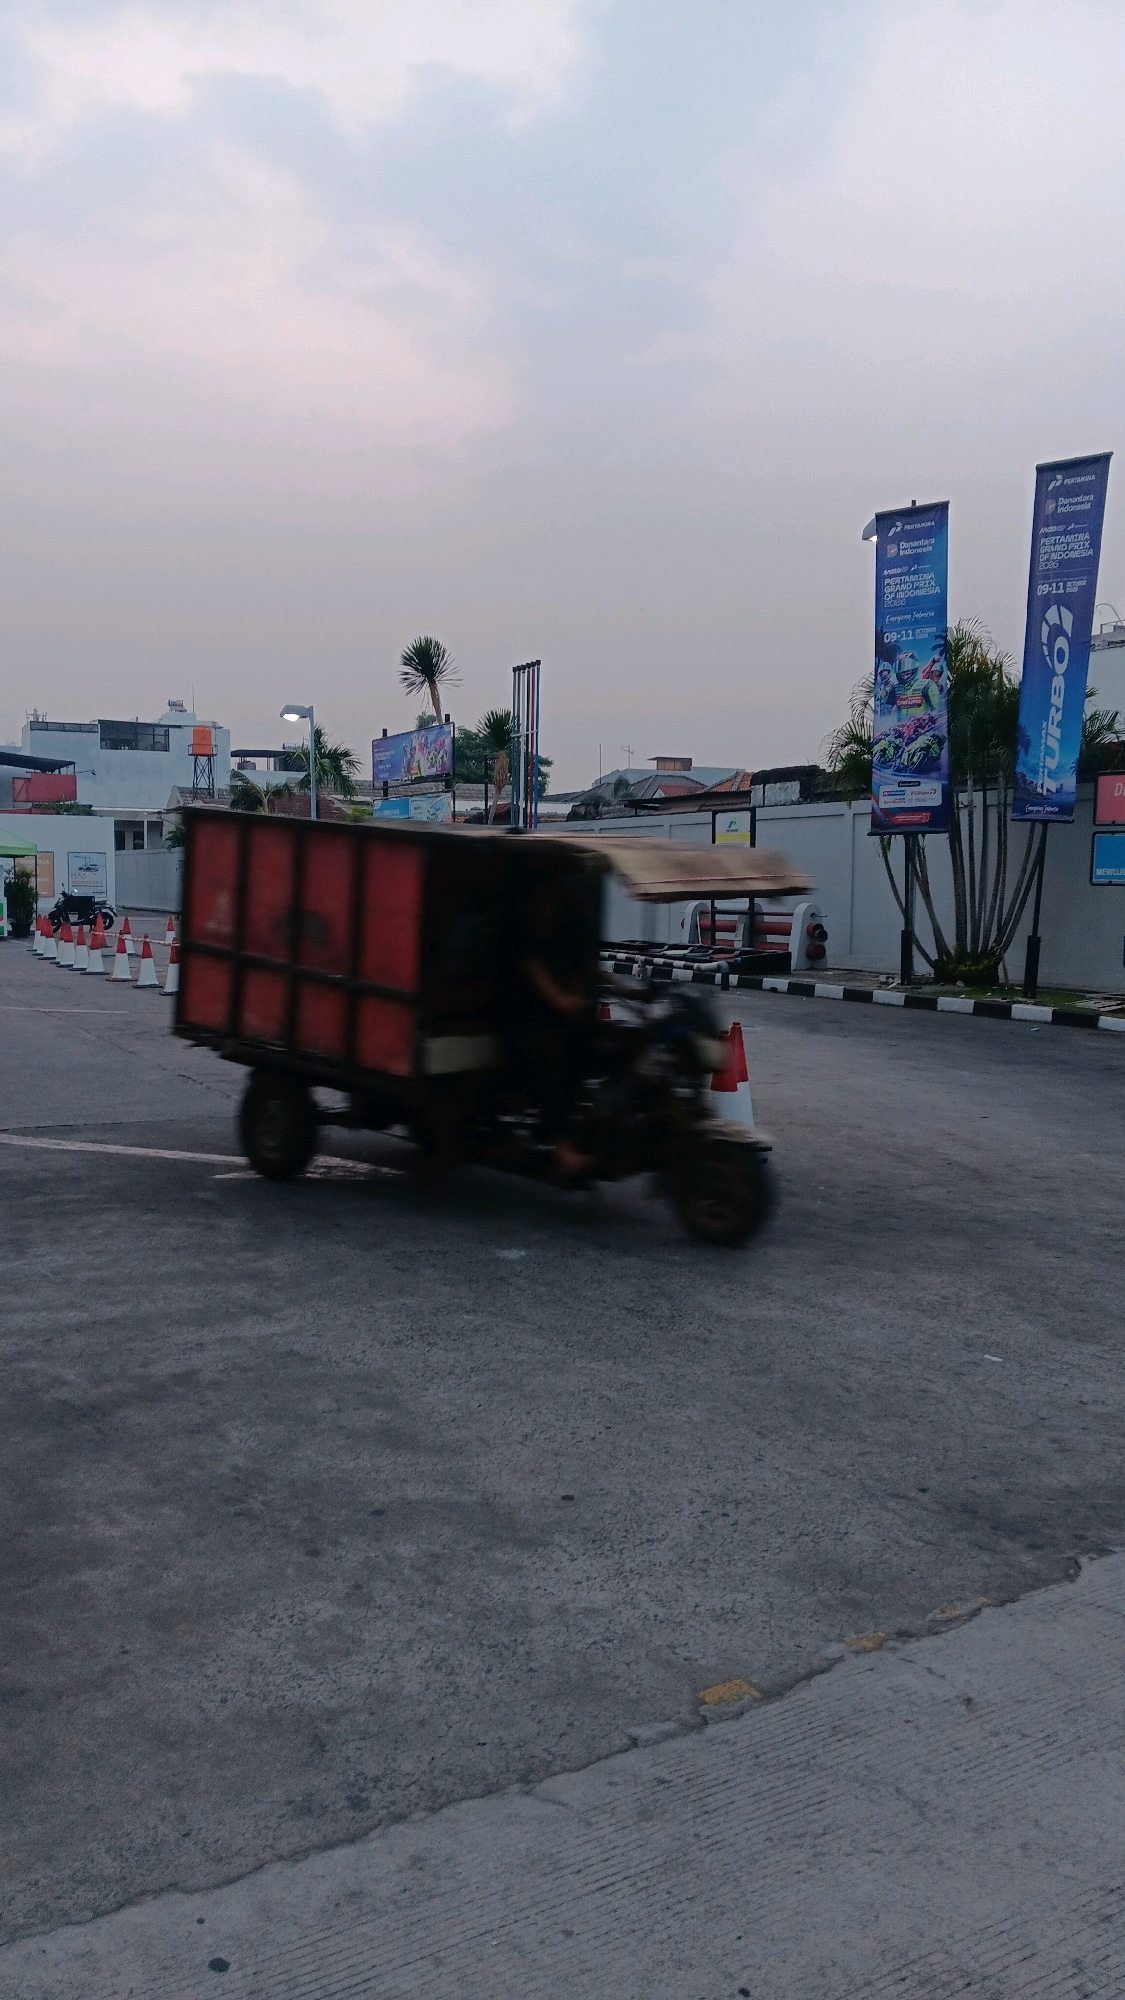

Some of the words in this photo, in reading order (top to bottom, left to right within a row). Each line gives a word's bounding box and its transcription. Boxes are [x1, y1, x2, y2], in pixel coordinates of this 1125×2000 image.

[1063, 474, 1096, 486] PERTAMINA
[1058, 494, 1094, 506] Danantara
[1057, 502, 1091, 514] Indonesia
[903, 520, 936, 531] PERTAMINA
[900, 537, 936, 550] Danantara
[1040, 532, 1090, 546] PERTAMINA
[900, 546, 933, 556] Indonesia
[1040, 543, 1068, 554] GRAND
[1068, 540, 1091, 550] PRIX
[1039, 552, 1049, 562] OF
[1050, 548, 1094, 560] INDONESIA
[884, 572, 936, 586] PERTAMINA
[884, 582, 912, 594] GRAND
[914, 578, 936, 590] PRIX
[884, 592, 896, 601] OF
[896, 586, 941, 598] INDONESIA
[1036, 582, 1064, 596] 09-11
[884, 598, 906, 608] 2026
[884, 630, 914, 644] 09-11
[1043, 636, 1070, 796] TURBO
